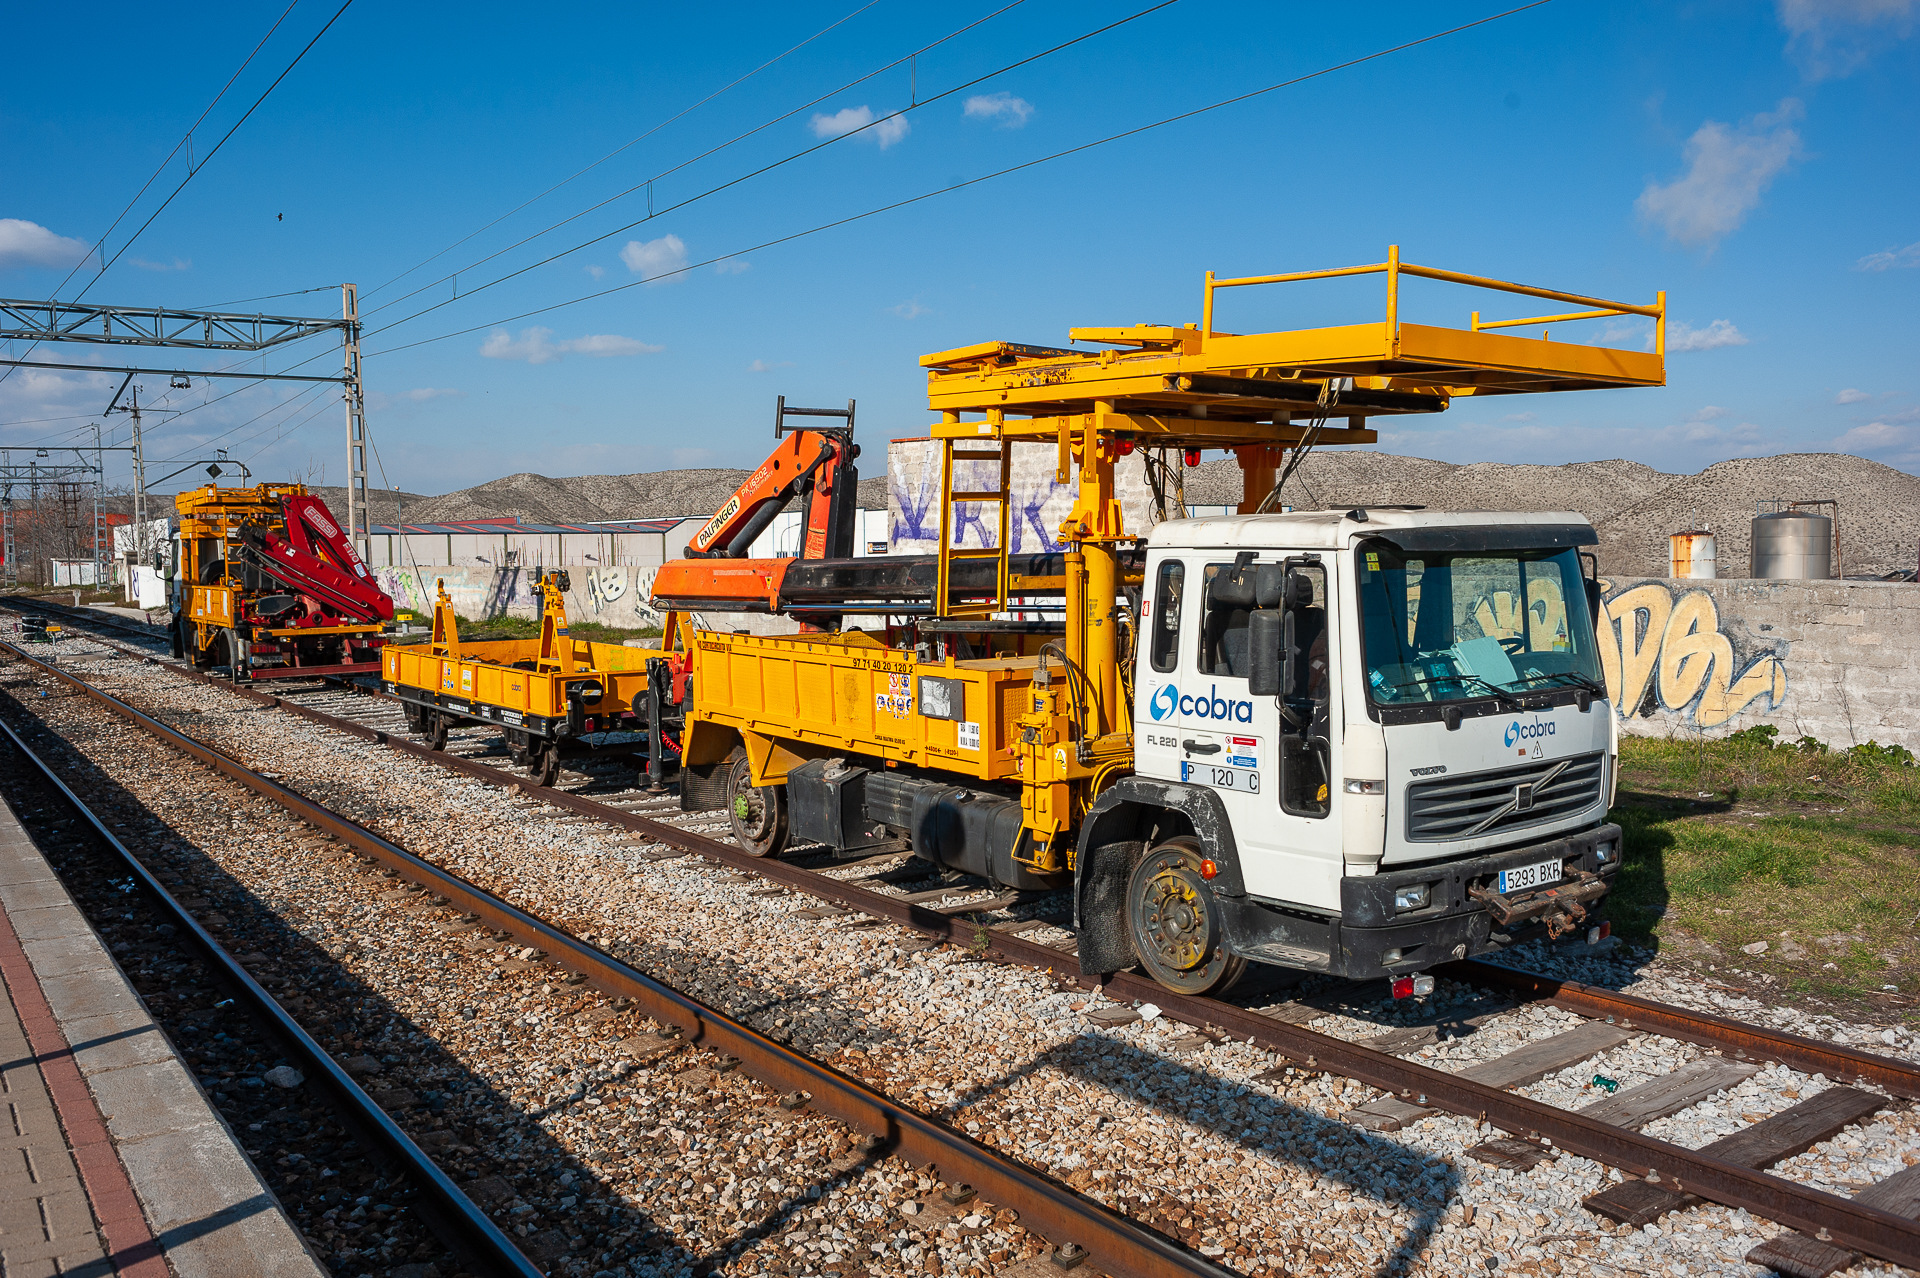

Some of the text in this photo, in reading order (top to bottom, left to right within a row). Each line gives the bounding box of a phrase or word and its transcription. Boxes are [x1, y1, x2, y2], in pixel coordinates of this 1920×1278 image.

[749, 466, 768, 489] 16502
[306, 507, 336, 536] FASSI
[699, 499, 738, 546] PALFINGER
[342, 541, 360, 563] F170
[853, 658, 913, 673] 97 71 40 20 120 2
[1180, 684, 1253, 723] cobra
[1520, 715, 1556, 740] cobra
[1147, 735, 1177, 748] FL 220
[1187, 764, 1257, 790] P 120 C
[1410, 765, 1447, 776] VOLVO
[1508, 868, 1535, 889] 5293
